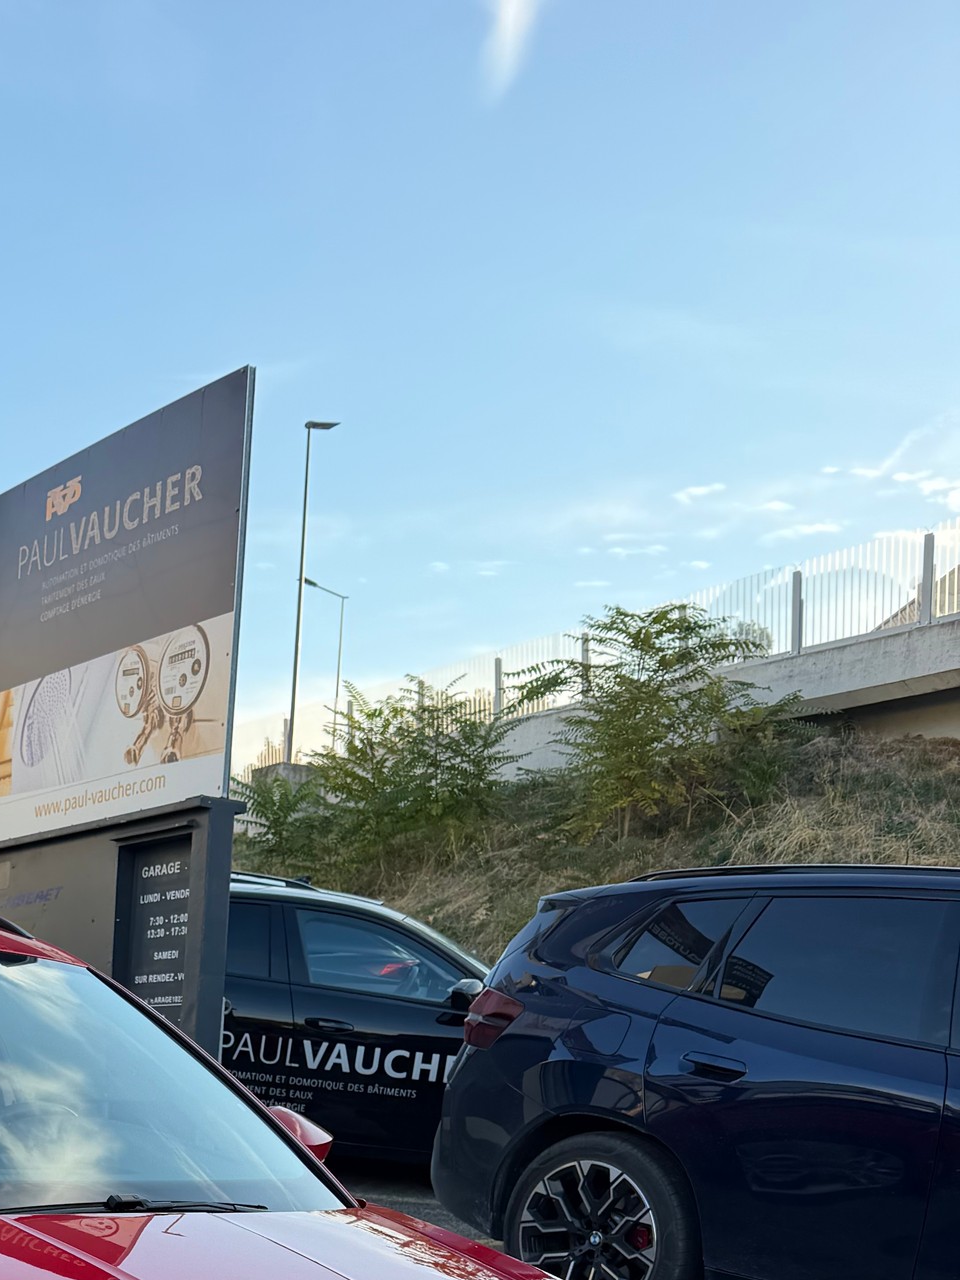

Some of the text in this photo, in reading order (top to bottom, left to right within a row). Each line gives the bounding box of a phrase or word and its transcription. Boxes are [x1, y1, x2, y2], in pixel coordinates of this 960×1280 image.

[34, 774, 166, 818] www.paul-vaucher.com
[141, 861, 181, 878] GARAGE
[140, 892, 161, 904] LUNDI
[149, 916, 164, 926] 7:30
[147, 928, 165, 939] 13:30
[153, 950, 179, 960] SAMEDI
[134, 975, 147, 984] SUR
[275, 1074, 286, 1084] ET
[289, 1076, 344, 1091] DOMOTIQUE
[347, 1082, 365, 1093] DES
[367, 1083, 417, 1099] BÂTIMENTS
[269, 1087, 286, 1097] DES
[289, 1089, 313, 1100] EAUX
